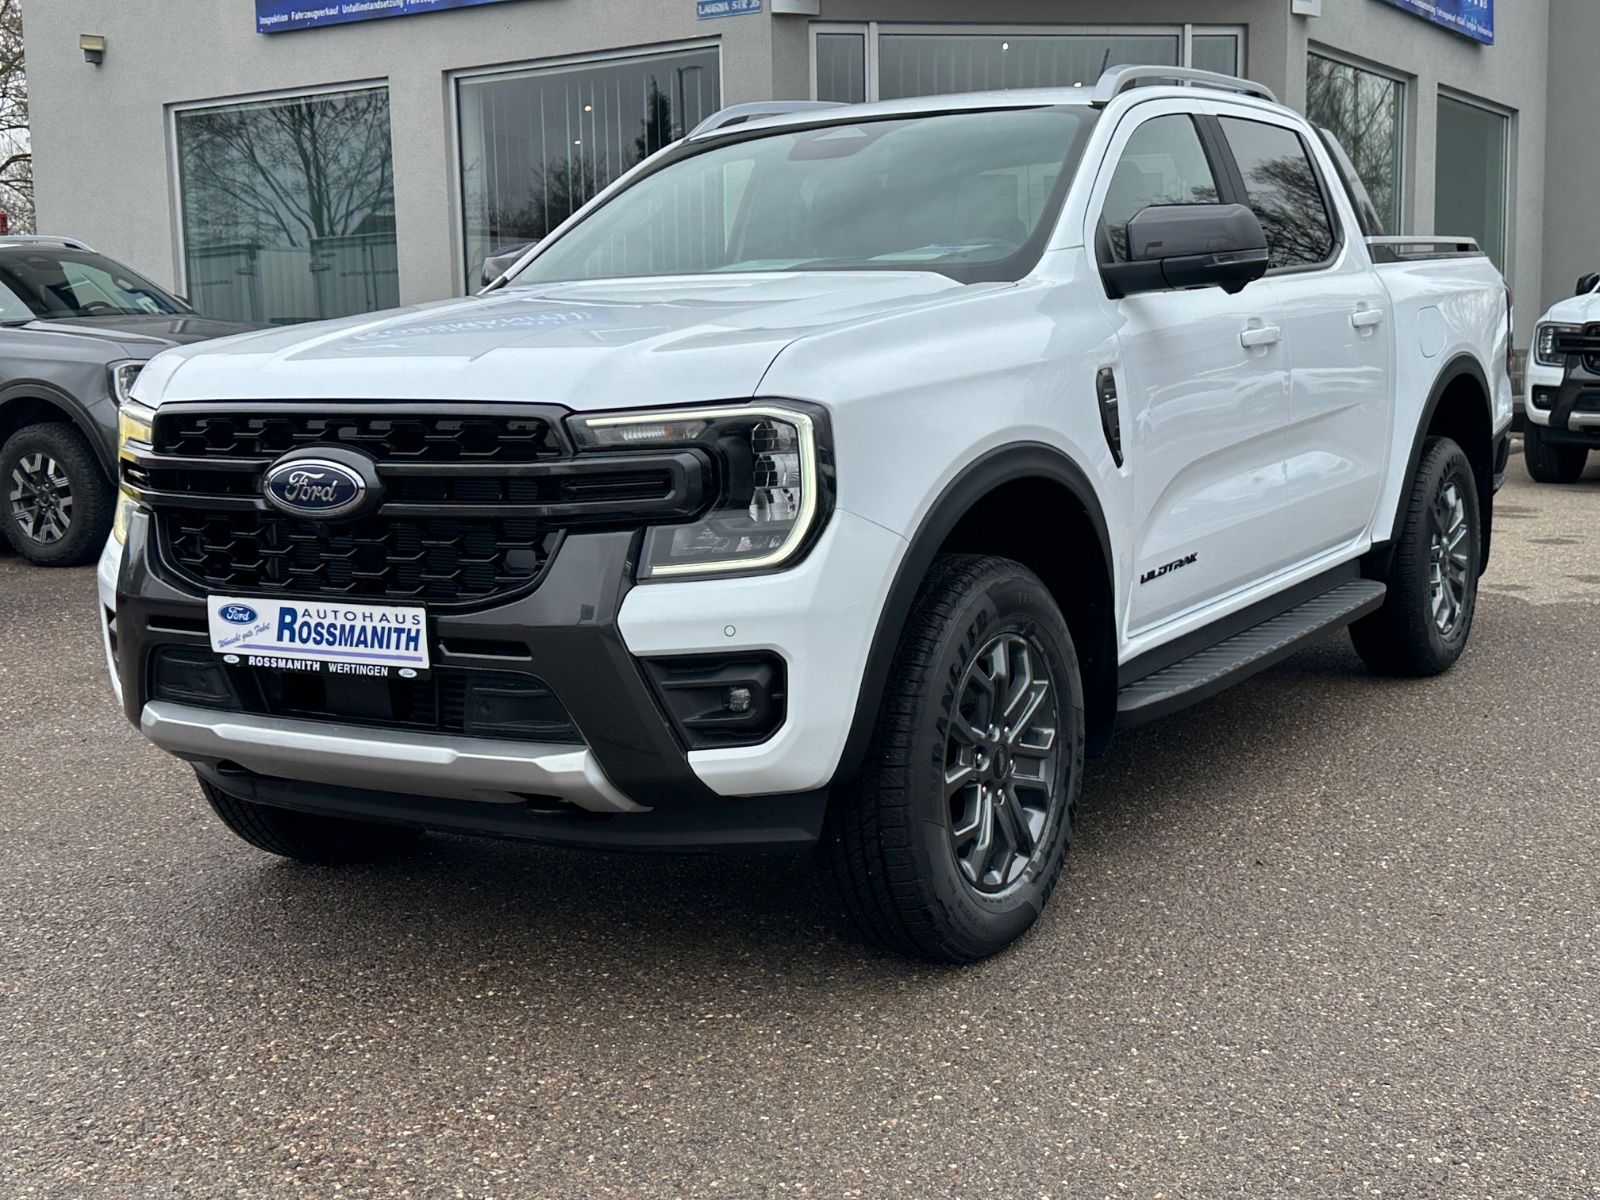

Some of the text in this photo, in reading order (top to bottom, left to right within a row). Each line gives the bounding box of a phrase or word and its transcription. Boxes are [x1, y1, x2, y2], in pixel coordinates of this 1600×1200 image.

[260, 0, 403, 25] Inspektion Fahrzeugverkauf Unfallinstandsetzung
[284, 470, 338, 502] Ford
[1140, 552, 1198, 585] WILDTRAK
[226, 606, 250, 621] Ford
[301, 608, 420, 626] AUTOHAUS
[276, 606, 421, 652] ROSSMANITH
[248, 656, 389, 677] ROSSMANITH WERTINGEN
